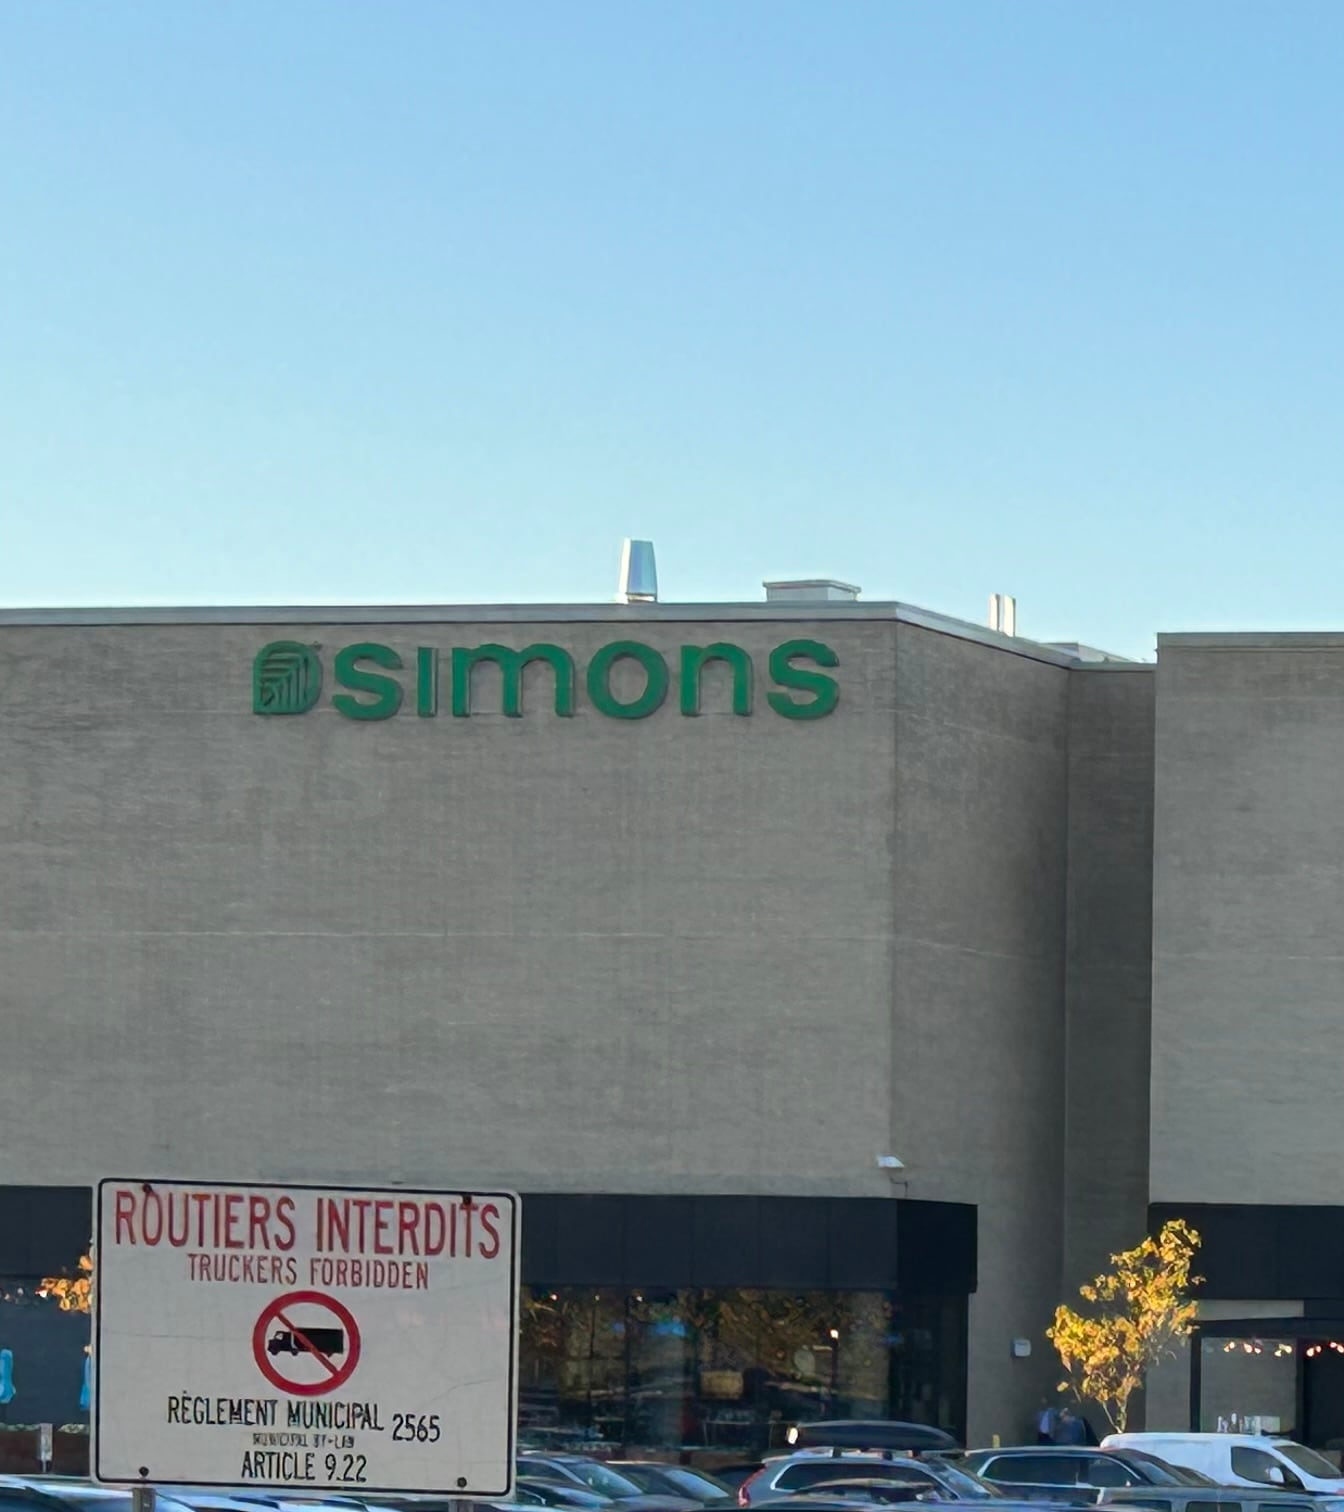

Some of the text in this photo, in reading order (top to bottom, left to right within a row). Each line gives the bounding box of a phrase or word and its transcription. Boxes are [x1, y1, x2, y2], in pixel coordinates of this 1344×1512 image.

[332, 639, 840, 721] simons
[115, 1189, 501, 1260] ROUTIERS INTERDITS
[187, 1253, 430, 1290] TRUCKERS FORBIDDEN
[287, 1400, 385, 1432] MUNICIPAL
[392, 1412, 441, 1443] 2565
[241, 1449, 367, 1483] ARTICLE 9.22
